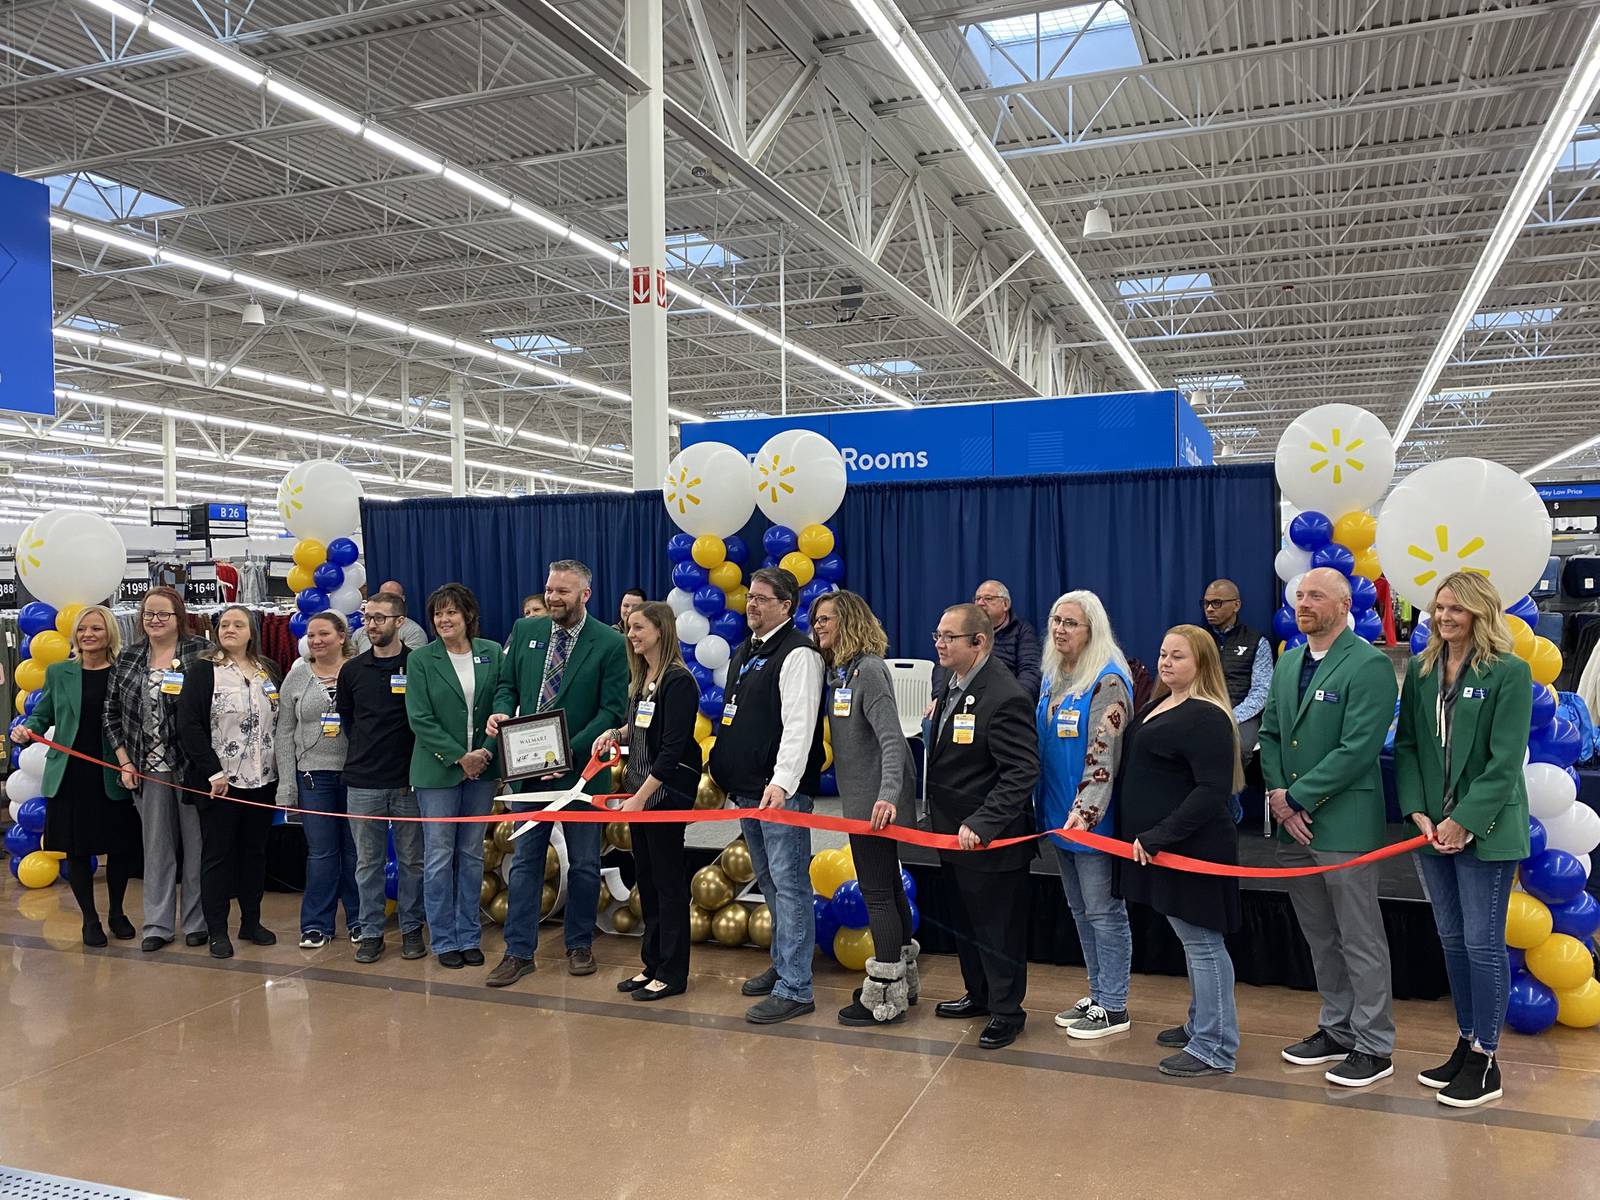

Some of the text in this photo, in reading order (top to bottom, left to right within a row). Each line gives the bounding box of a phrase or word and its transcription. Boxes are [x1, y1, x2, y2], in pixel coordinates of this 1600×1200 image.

[841, 447, 928, 471] Rooms
[1567, 488, 1583, 496] Price
[220, 507, 240, 518] B 26
[519, 735, 548, 745] WALMART
